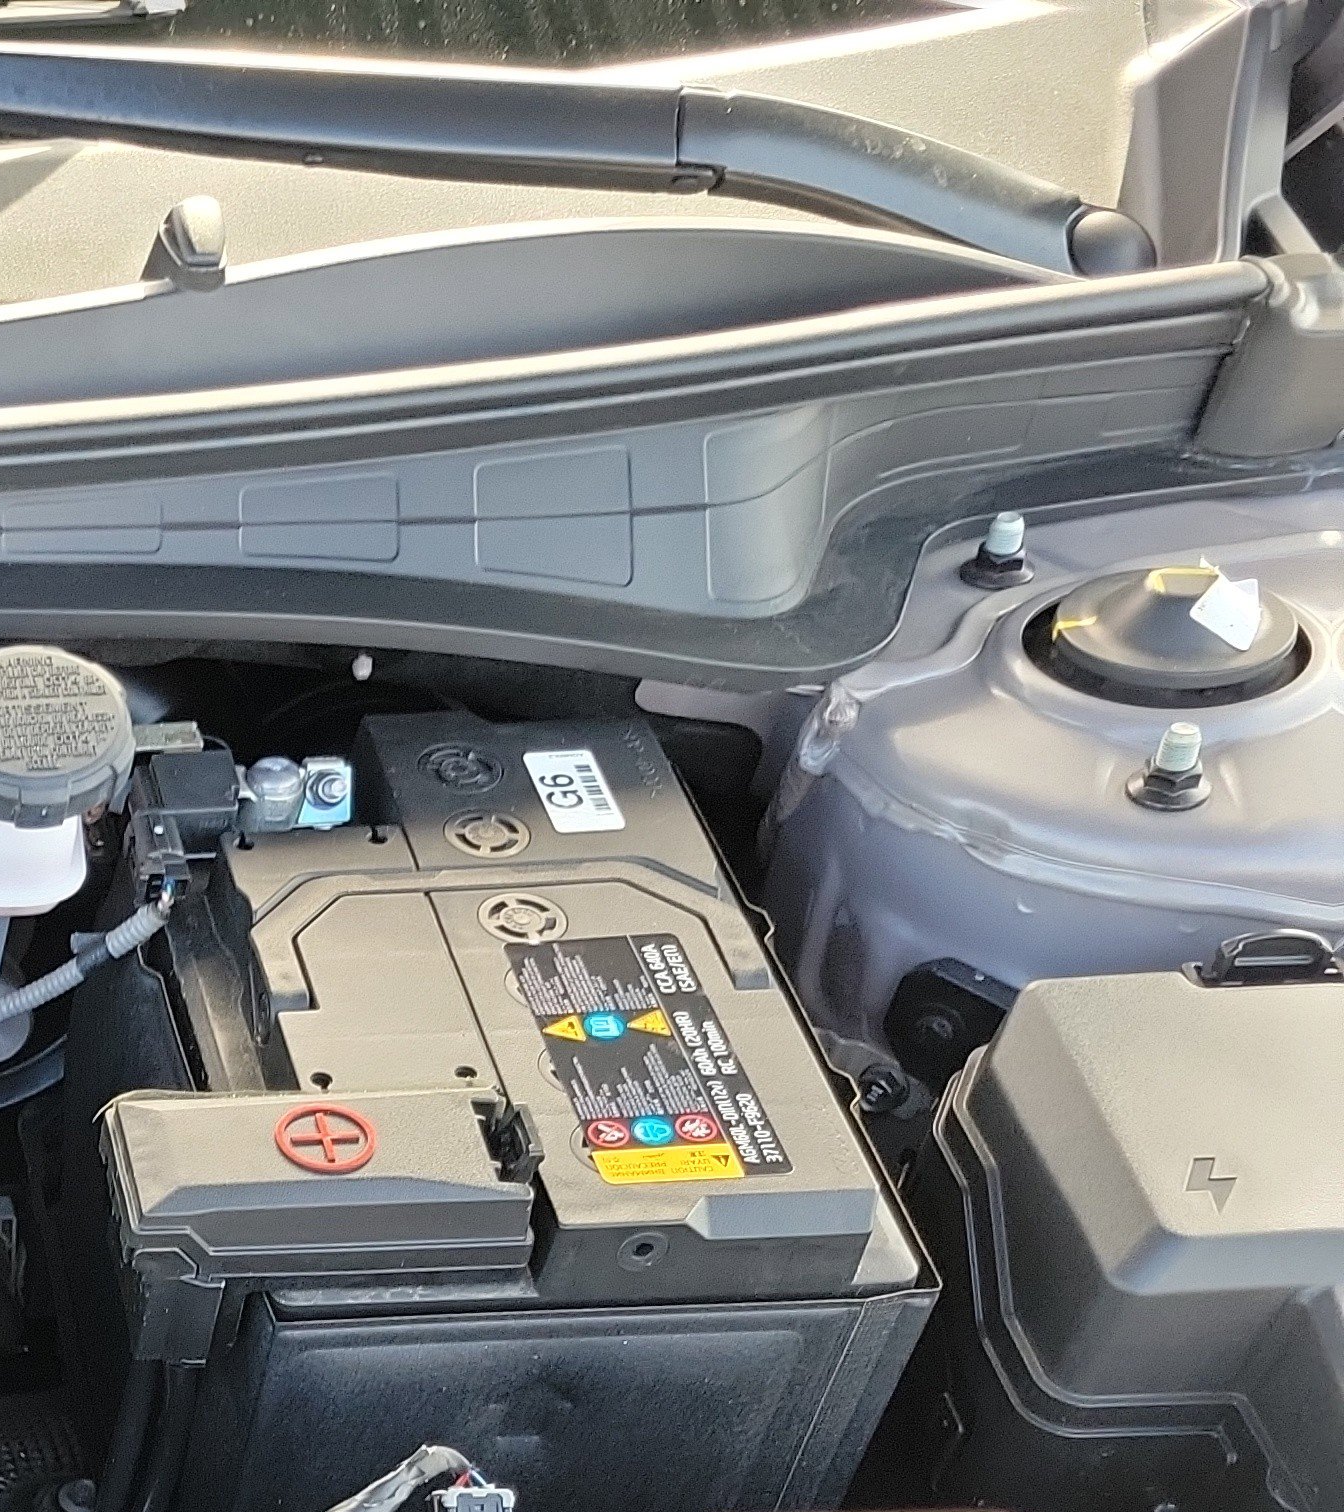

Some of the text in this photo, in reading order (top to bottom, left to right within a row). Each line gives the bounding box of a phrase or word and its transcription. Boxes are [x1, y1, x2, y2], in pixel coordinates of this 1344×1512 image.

[538, 774, 584, 809] G6
[641, 943, 677, 994] CCA 640A
[673, 1011, 702, 1048] (20HR)
